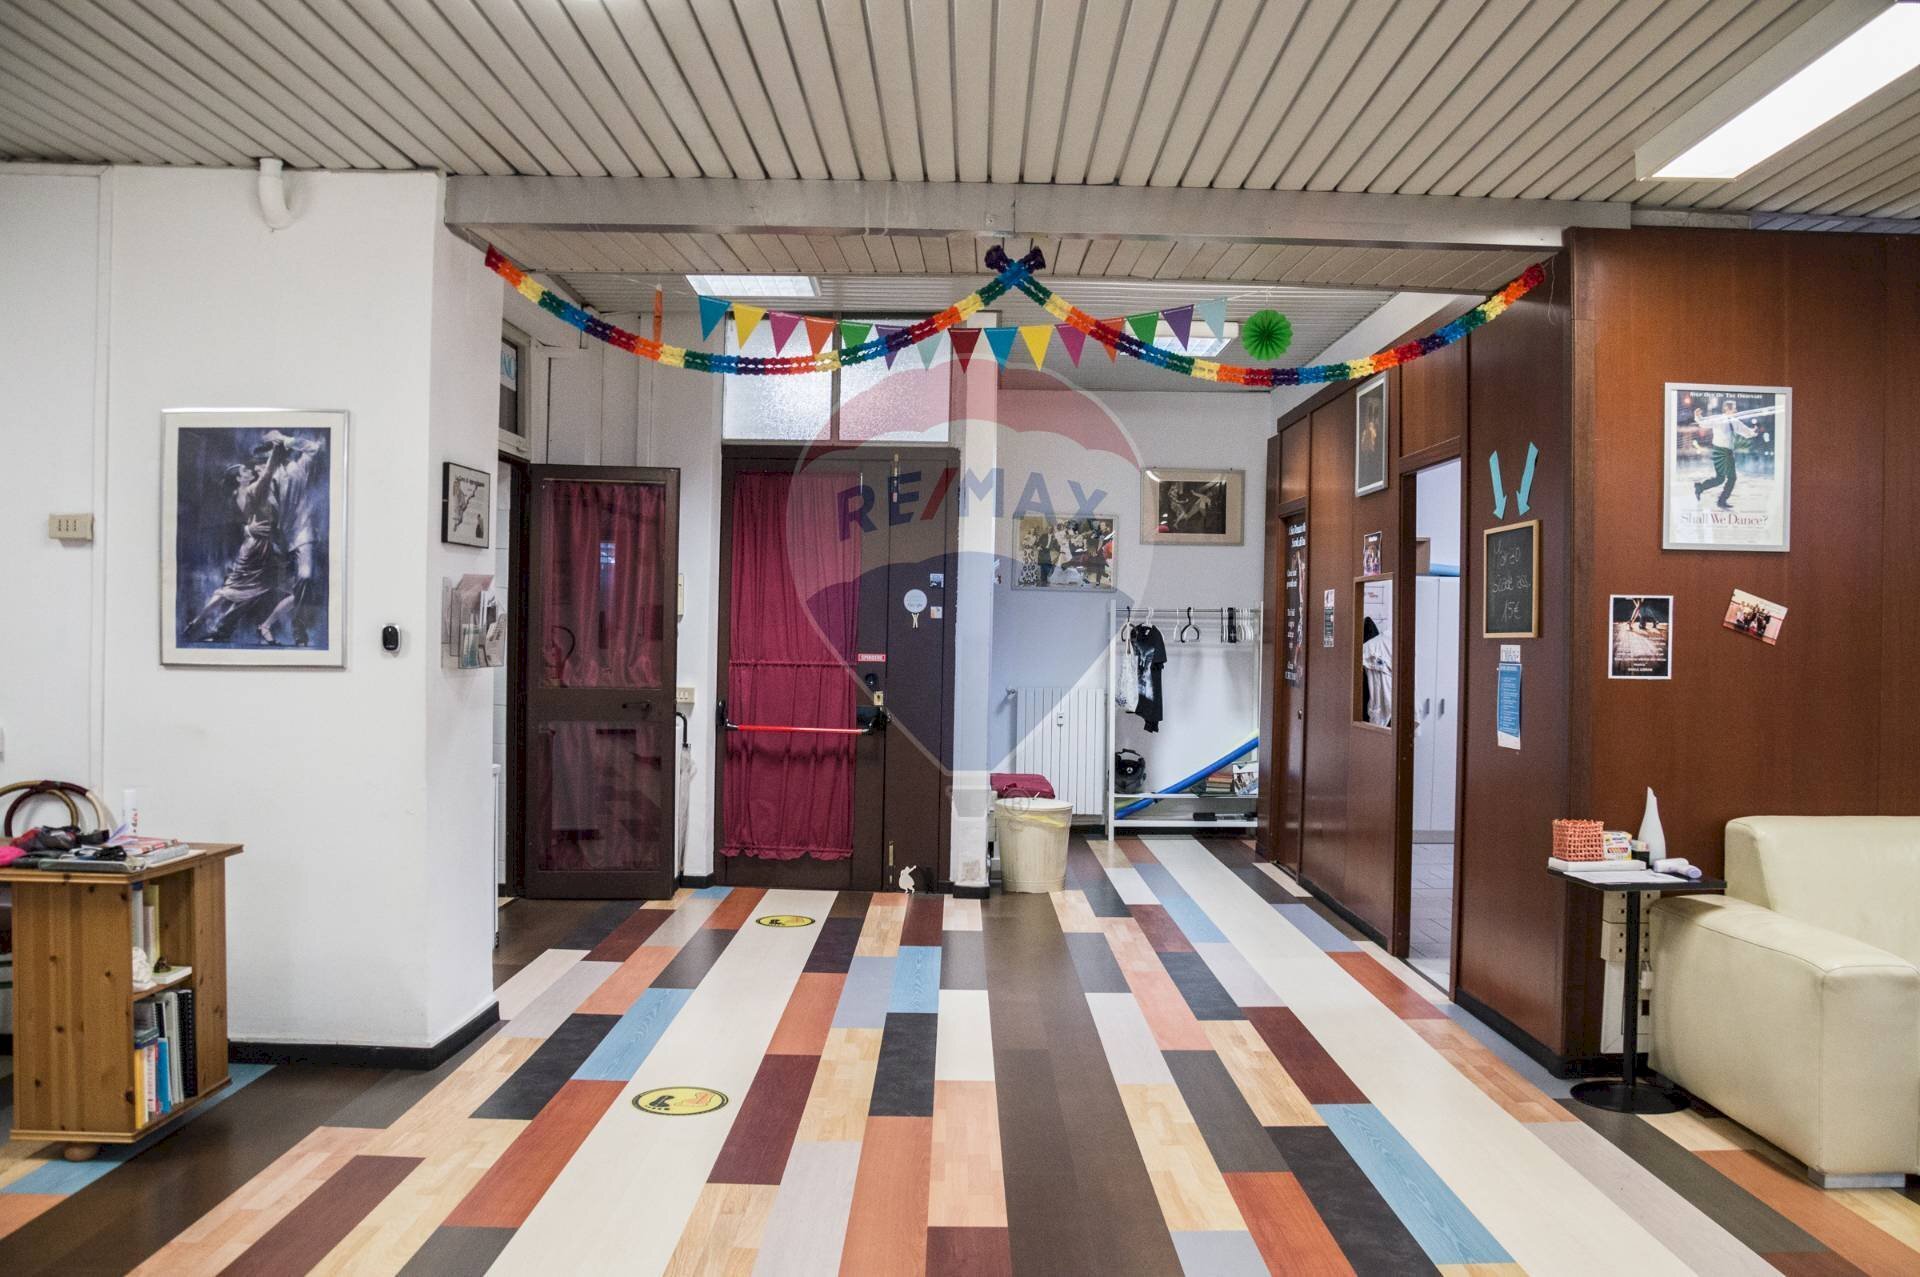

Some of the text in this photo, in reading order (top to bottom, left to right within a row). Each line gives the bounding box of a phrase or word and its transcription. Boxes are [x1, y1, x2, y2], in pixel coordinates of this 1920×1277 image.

[1681, 513, 1768, 525] Shall We Dance?
